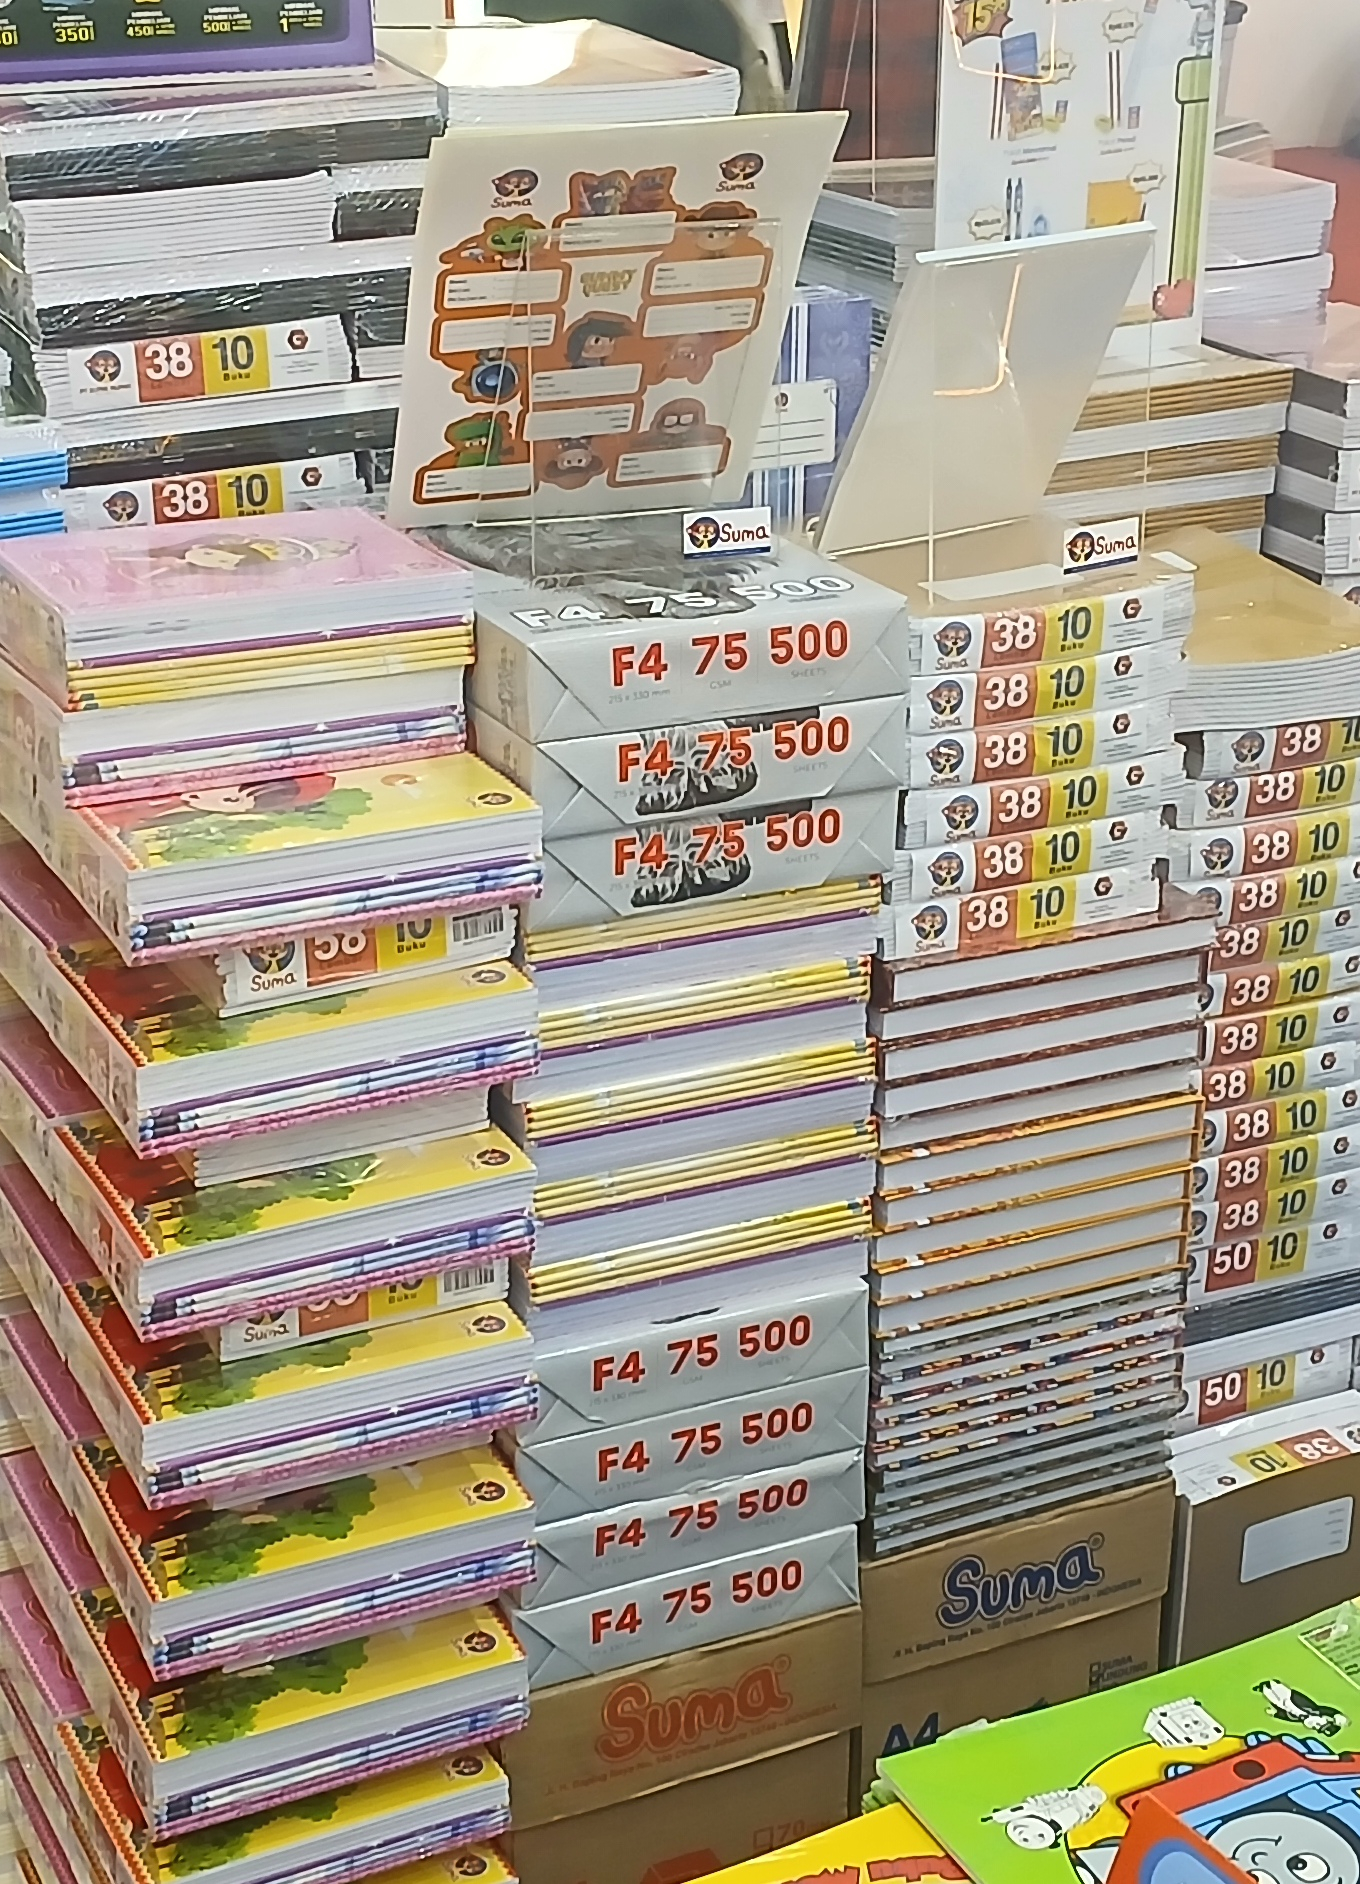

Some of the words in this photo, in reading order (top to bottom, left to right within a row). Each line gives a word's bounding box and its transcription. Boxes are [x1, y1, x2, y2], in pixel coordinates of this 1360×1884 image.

[144, 342, 194, 380] 38
[212, 335, 254, 371] 10
[223, 371, 251, 382] Buku
[162, 481, 208, 518] 38
[228, 474, 268, 508] 10
[719, 523, 769, 543] Suma
[1095, 534, 1137, 556] Suma
[510, 603, 607, 629] F4
[624, 590, 719, 616] 75
[729, 574, 854, 601] 500
[992, 615, 1037, 653] 38
[1057, 606, 1092, 642] 10
[612, 643, 668, 687] F4
[691, 632, 748, 676] 75
[770, 620, 848, 665] 500
[790, 667, 827, 680] SHEETS
[983, 673, 1029, 711] 38
[1049, 665, 1085, 700] 10
[618, 740, 674, 783] F4
[698, 728, 752, 771] 75
[774, 716, 849, 760] 500
[983, 731, 1028, 769] 38
[1047, 722, 1083, 757] 10
[1281, 723, 1322, 757] 38
[998, 785, 1041, 823] 38
[1062, 775, 1097, 809] 10
[1255, 771, 1295, 804] 38
[1314, 763, 1346, 794] 10
[614, 834, 668, 876] F4
[693, 822, 745, 863] 75
[766, 808, 840, 851] 500
[983, 841, 1024, 879] 38
[1045, 831, 1080, 865] 10
[1251, 831, 1290, 864] 38
[1308, 821, 1340, 852] 10
[966, 895, 1009, 932] 38
[1030, 886, 1065, 920] 10
[1239, 878, 1278, 912] 38
[1297, 870, 1327, 901] 10
[397, 941, 427, 954] Buku
[1220, 927, 1260, 959] 38
[1279, 919, 1309, 949] 10
[251, 973, 297, 992] Suma
[1230, 975, 1271, 1006] 38
[1290, 966, 1320, 995] 10
[1220, 1022, 1258, 1055] 38
[1276, 1014, 1307, 1043] 10
[1207, 1069, 1247, 1103] 38
[1265, 1061, 1295, 1091] 10
[1232, 1108, 1270, 1142] 38
[1286, 1099, 1317, 1130] 10
[1223, 1156, 1261, 1189] 38
[1279, 1146, 1309, 1176] 10
[1222, 1199, 1260, 1231] 38
[1278, 1189, 1307, 1218] 10
[1213, 1242, 1252, 1275] 50
[1267, 1232, 1299, 1262] 10
[243, 1324, 290, 1343] Suma
[593, 1351, 646, 1392] F4
[667, 1333, 718, 1375] 75
[739, 1315, 810, 1358] 500
[1204, 1372, 1242, 1407] 50
[1256, 1359, 1286, 1390] 10
[598, 1440, 650, 1482] F4
[671, 1422, 722, 1464] 75
[742, 1402, 813, 1445] 500
[1293, 1437, 1339, 1460] 38
[595, 1517, 646, 1557] F4
[668, 1499, 718, 1538] 75
[738, 1478, 808, 1519] 500
[591, 1602, 643, 1644] F4
[663, 1581, 712, 1624] 75
[732, 1560, 802, 1603] 500
[936, 1541, 1105, 1629] Suma
[596, 1663, 793, 1762] Suma
[882, 1712, 939, 1757] A4
